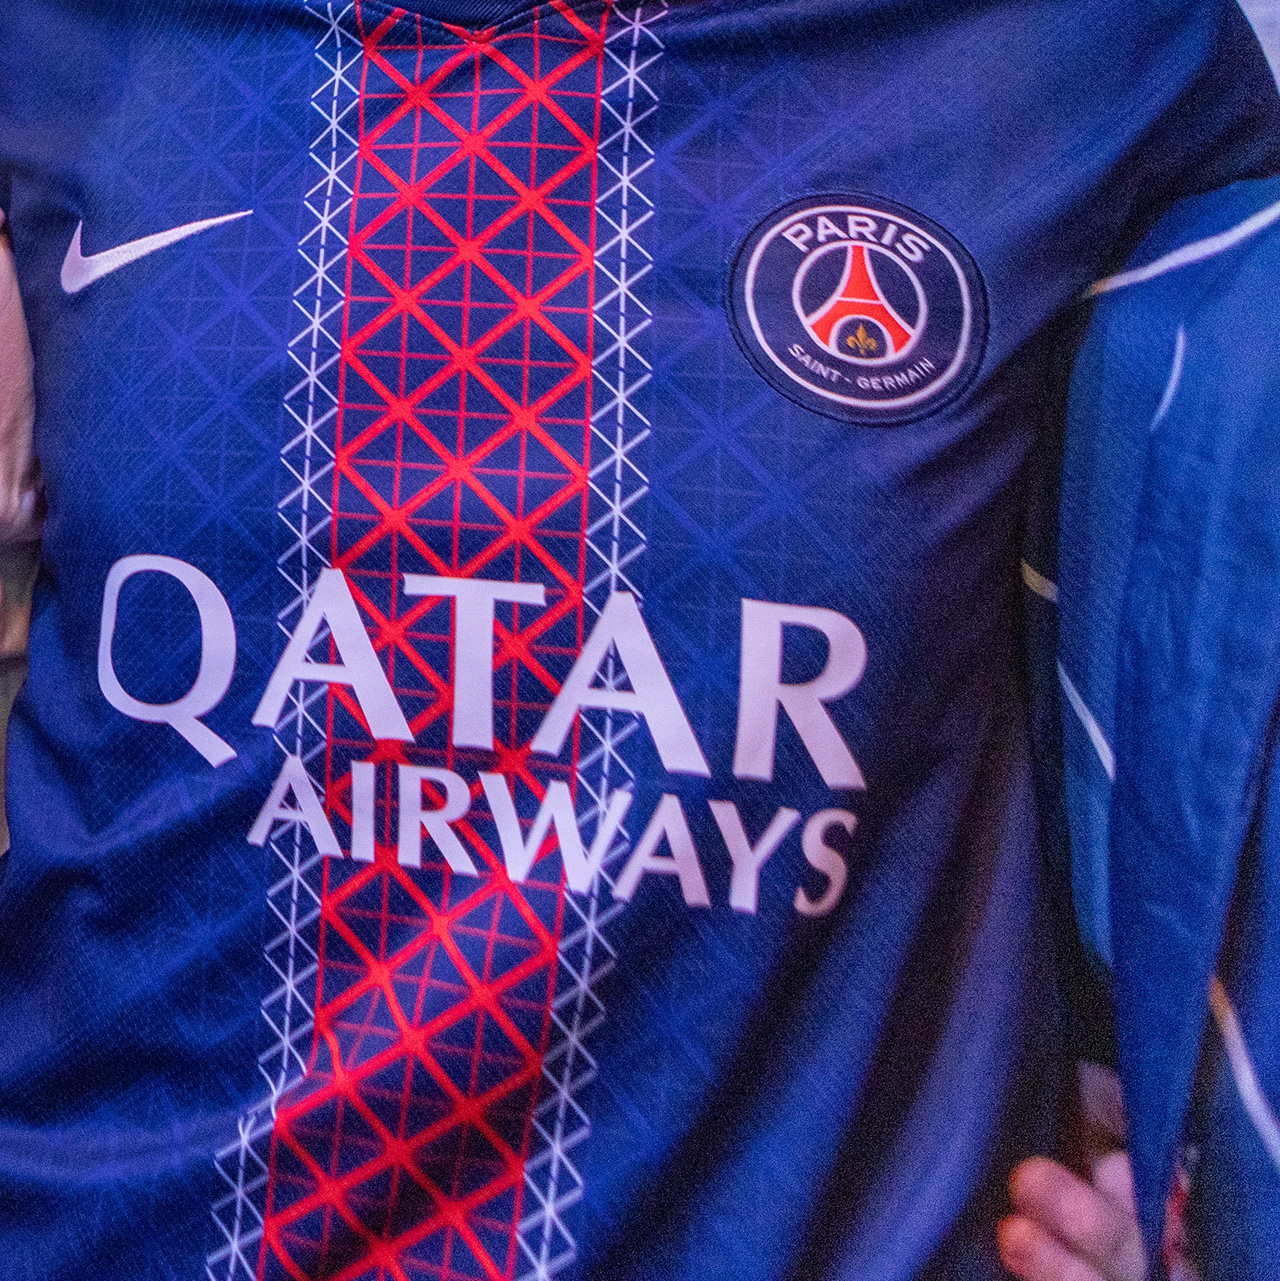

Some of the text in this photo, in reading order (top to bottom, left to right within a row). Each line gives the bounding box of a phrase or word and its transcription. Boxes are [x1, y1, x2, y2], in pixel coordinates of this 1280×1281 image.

[782, 215, 931, 263] PARIS
[97, 554, 867, 790] QATAR
[247, 754, 858, 917] AIRWAYS
